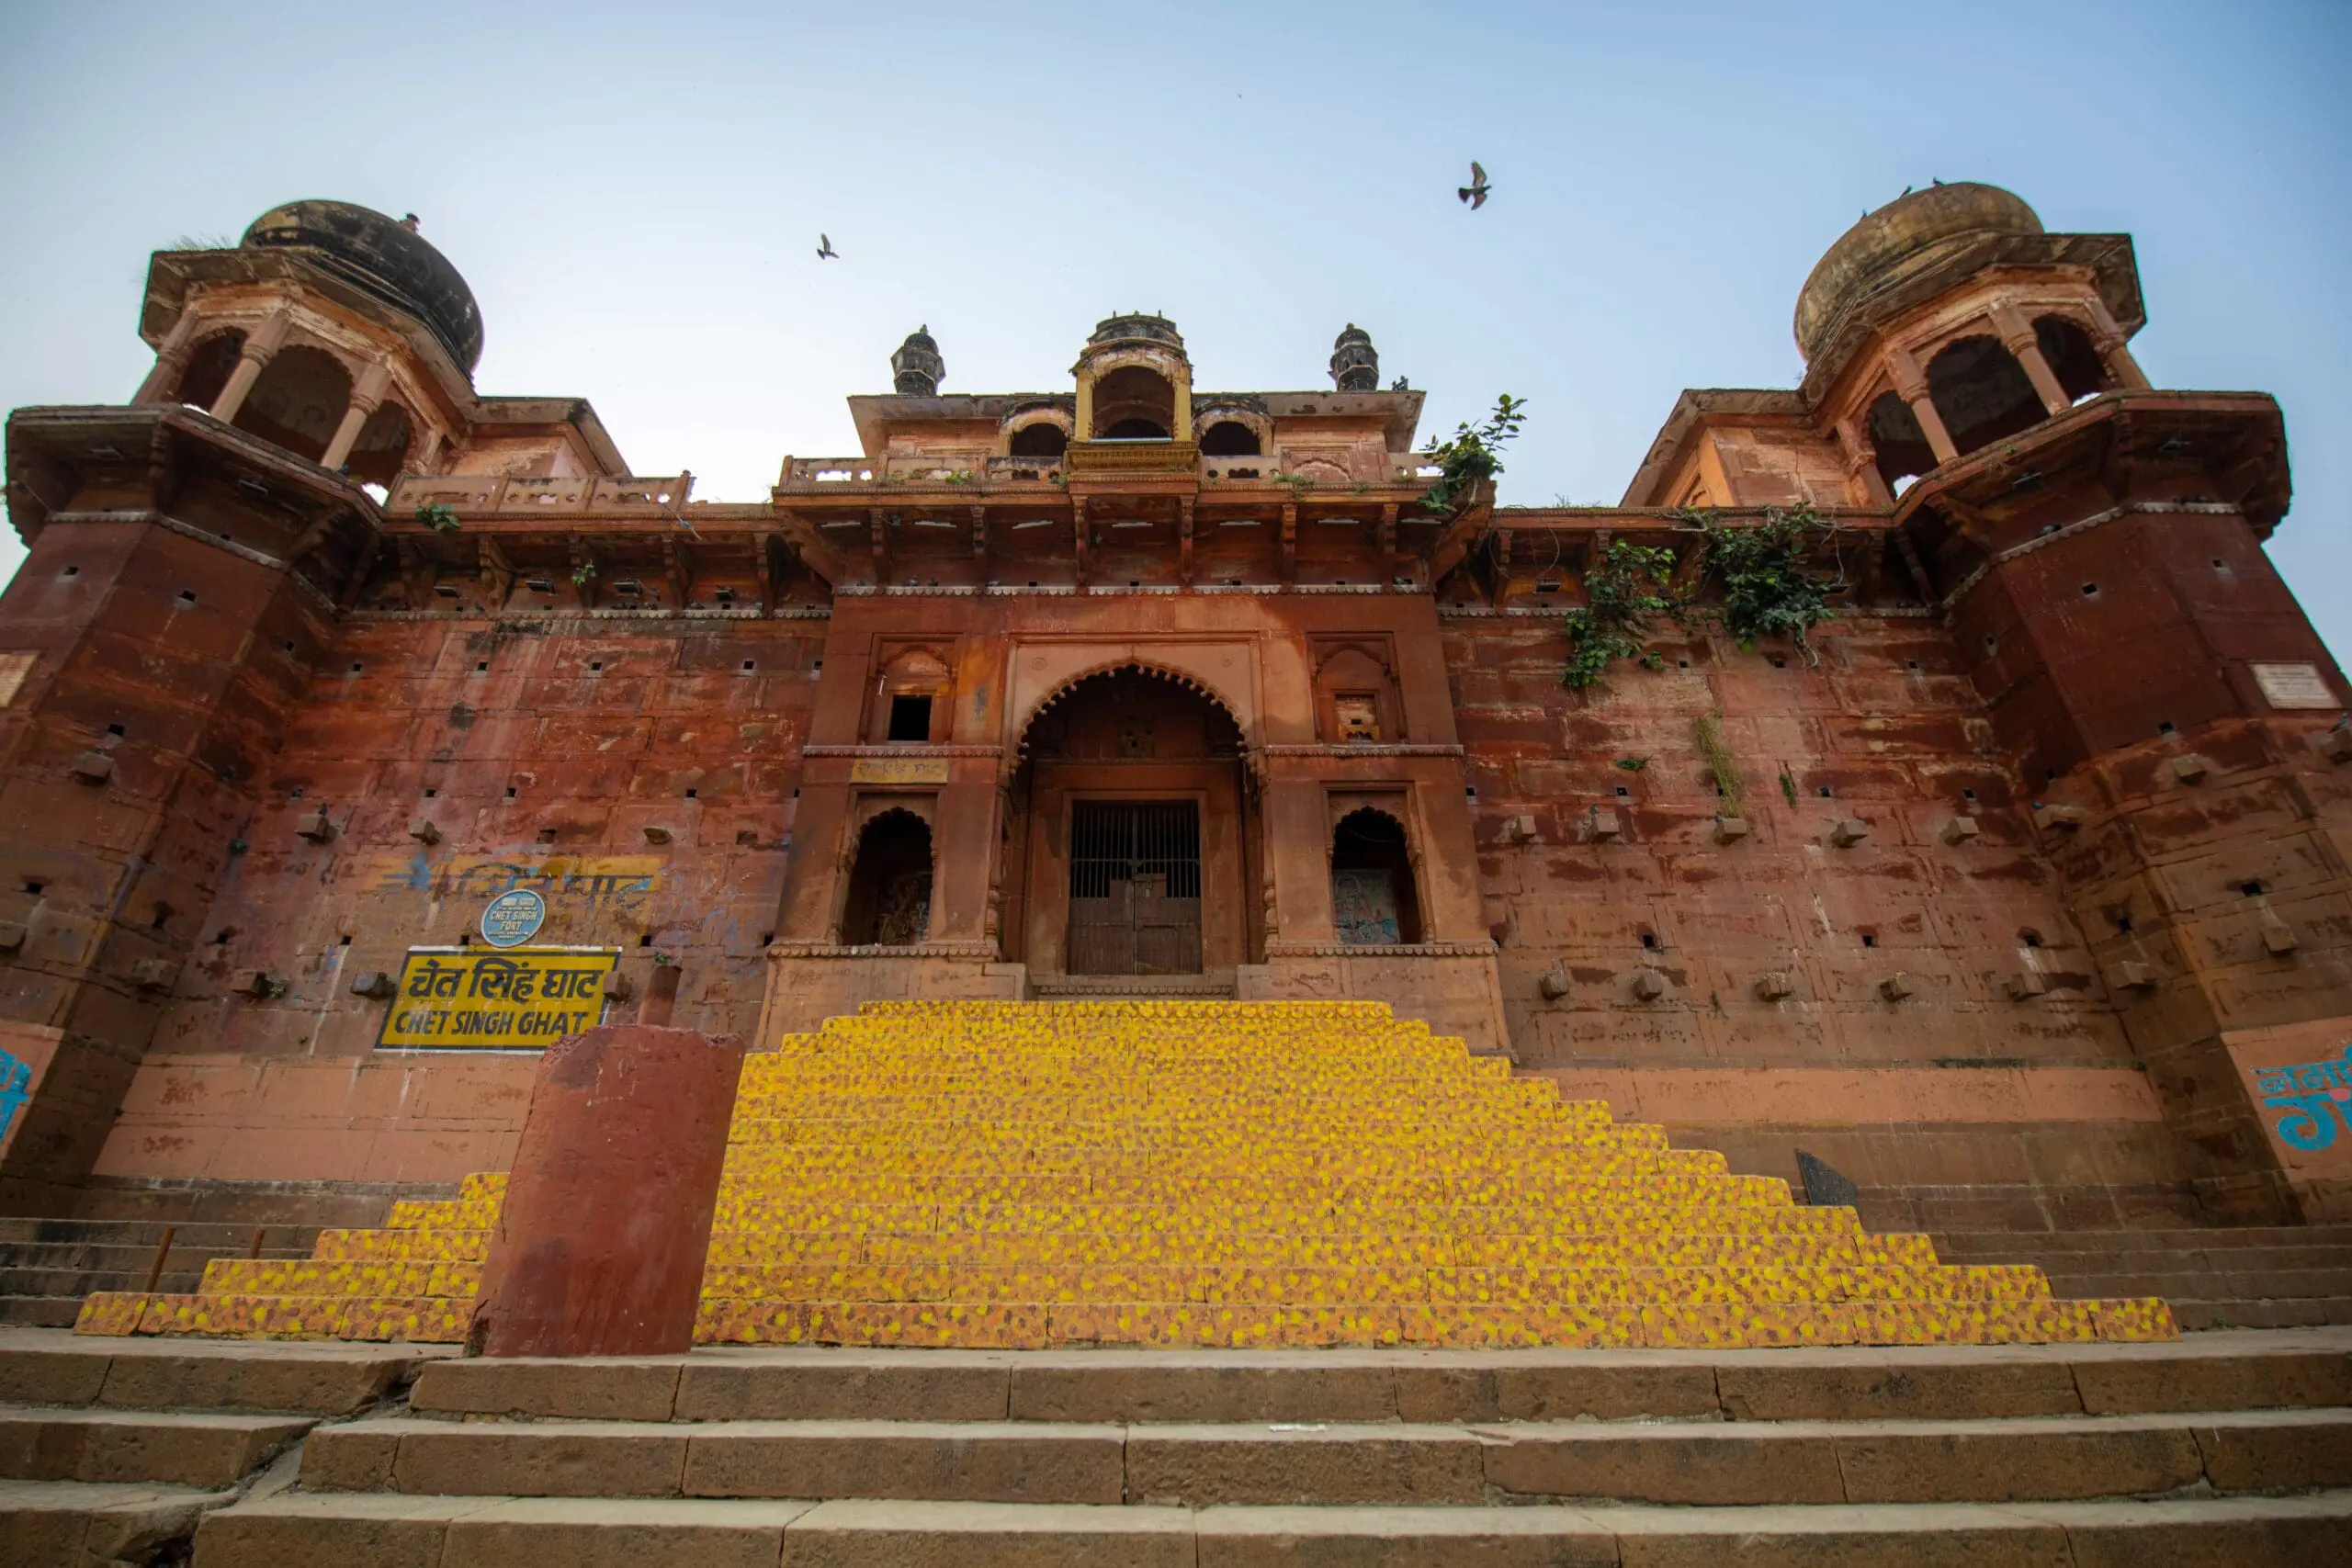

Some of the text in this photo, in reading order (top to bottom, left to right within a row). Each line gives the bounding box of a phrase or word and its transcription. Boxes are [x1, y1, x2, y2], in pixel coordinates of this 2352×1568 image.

[491, 910, 538, 920] CHET SINGH
[499, 921, 523, 931] FORT
[408, 958, 467, 998] चेत
[541, 969, 605, 999] घाट
[395, 1011, 588, 1035] CHET SINGH GHAT
